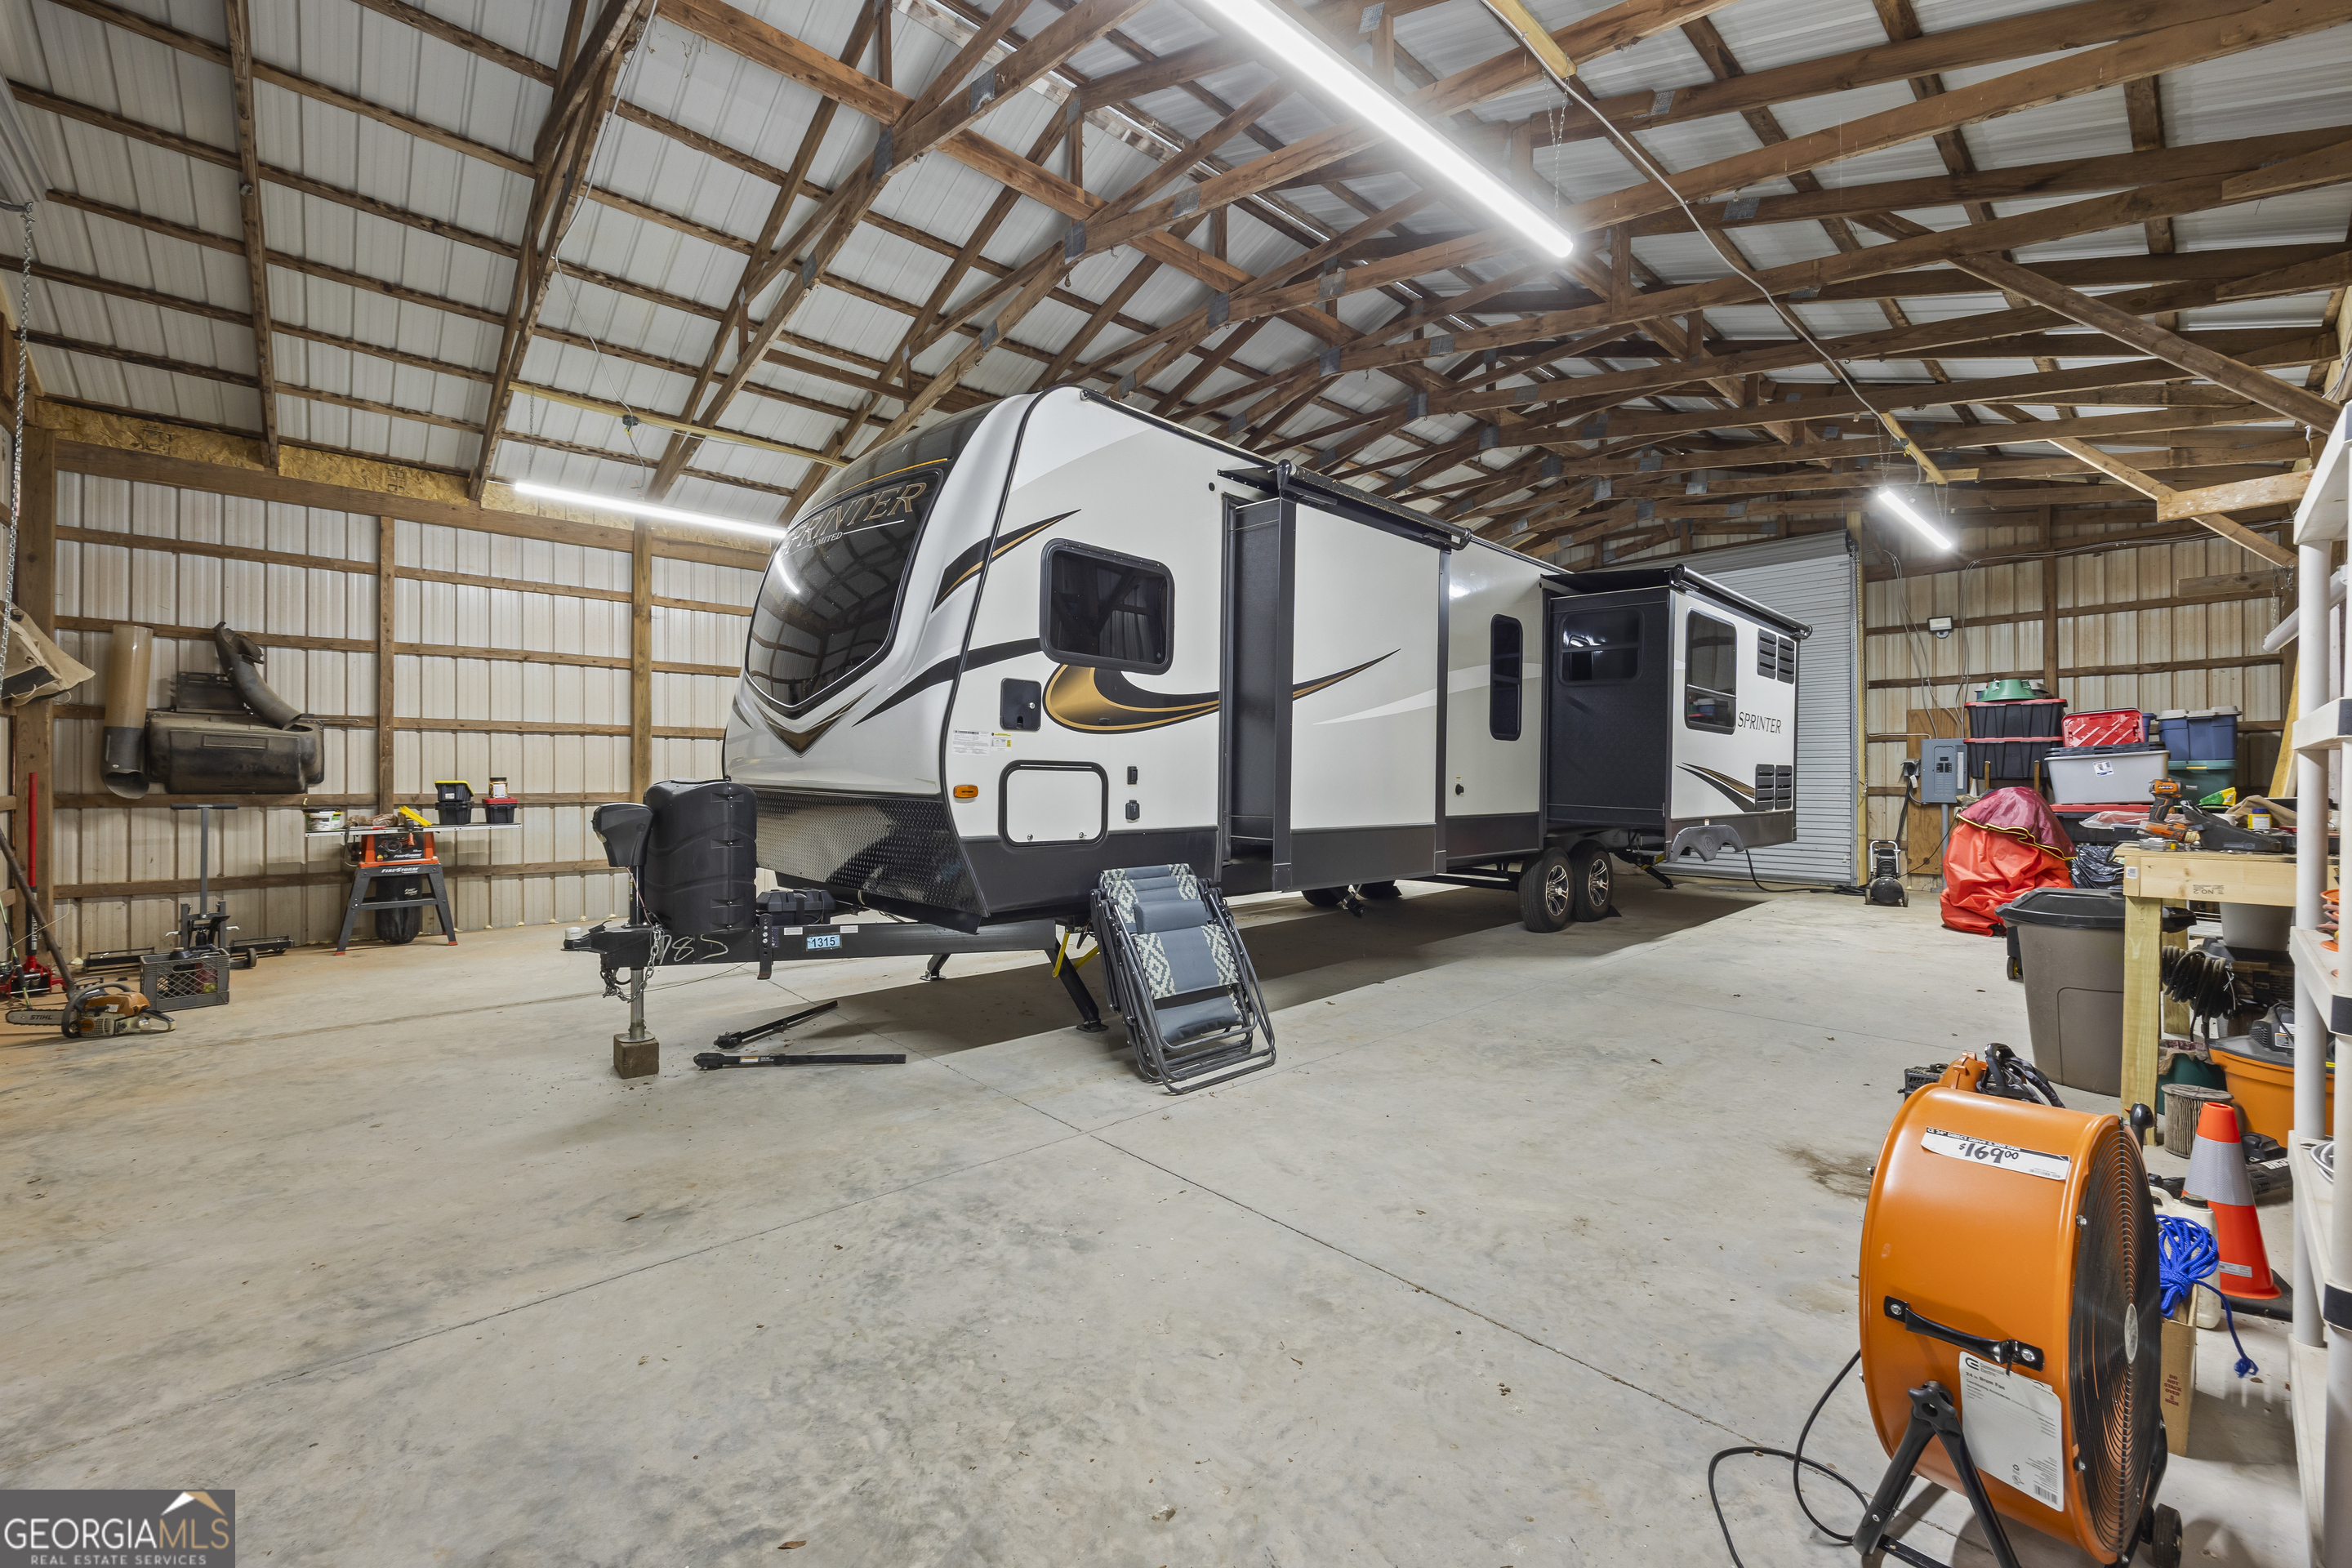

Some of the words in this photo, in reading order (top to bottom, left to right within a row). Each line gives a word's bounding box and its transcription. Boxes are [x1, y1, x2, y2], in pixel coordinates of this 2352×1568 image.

[782, 482, 927, 555] SPRINTER
[809, 532, 843, 548] LIMITED
[1738, 711, 1781, 733] SPRINTER
[812, 937, 835, 947] 1315
[2164, 1383, 2181, 1392] STACK
[2165, 1388, 2180, 1396] OVER
